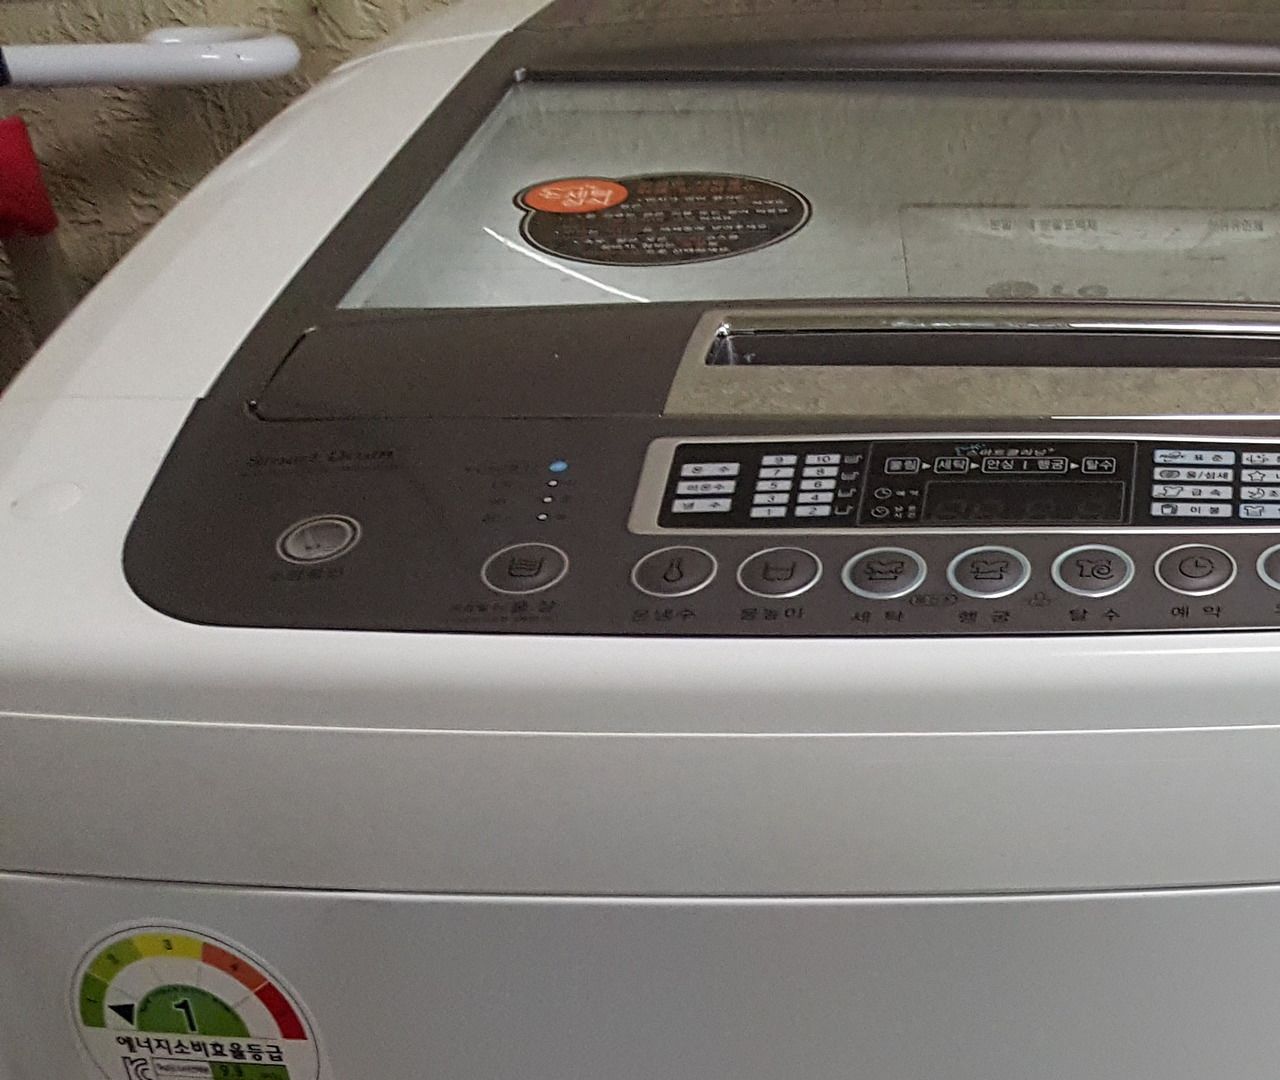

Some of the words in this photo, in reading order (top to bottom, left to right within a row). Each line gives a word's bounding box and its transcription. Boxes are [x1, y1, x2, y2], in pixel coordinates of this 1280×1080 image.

[1086, 459, 1112, 471] 탈수
[1069, 608, 1120, 622] 탈수
[1171, 605, 1222, 619] 예약
[173, 998, 197, 1032] 1
[115, 1034, 284, 1062] 에너지소비효율등급
